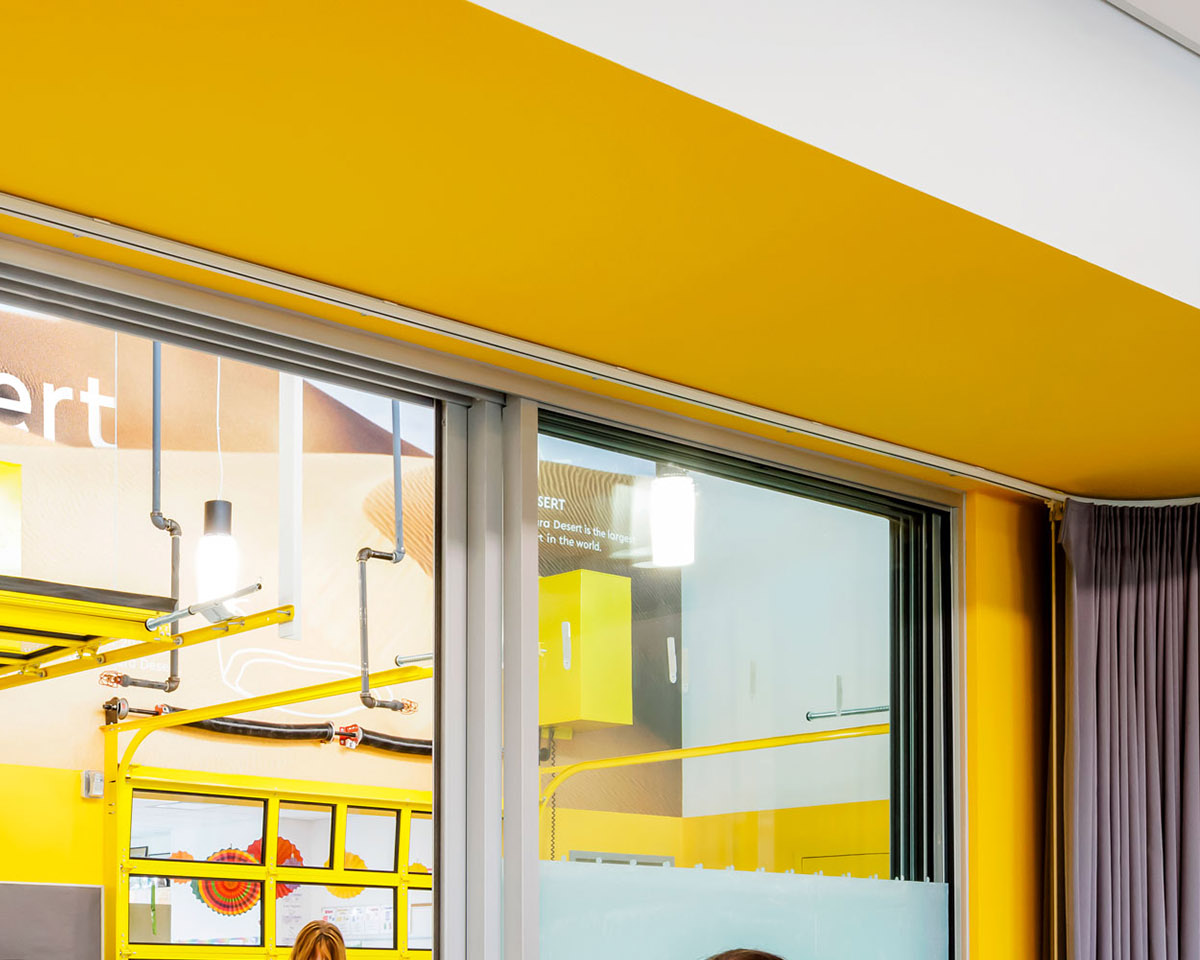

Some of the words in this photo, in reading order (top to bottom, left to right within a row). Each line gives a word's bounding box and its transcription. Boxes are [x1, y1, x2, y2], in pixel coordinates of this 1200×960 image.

[553, 520, 582, 533] Desert
[584, 523, 591, 535] is
[593, 526, 606, 538] the
[546, 533, 557, 544] in
[559, 534, 575, 547] the
[576, 538, 602, 552] world.
